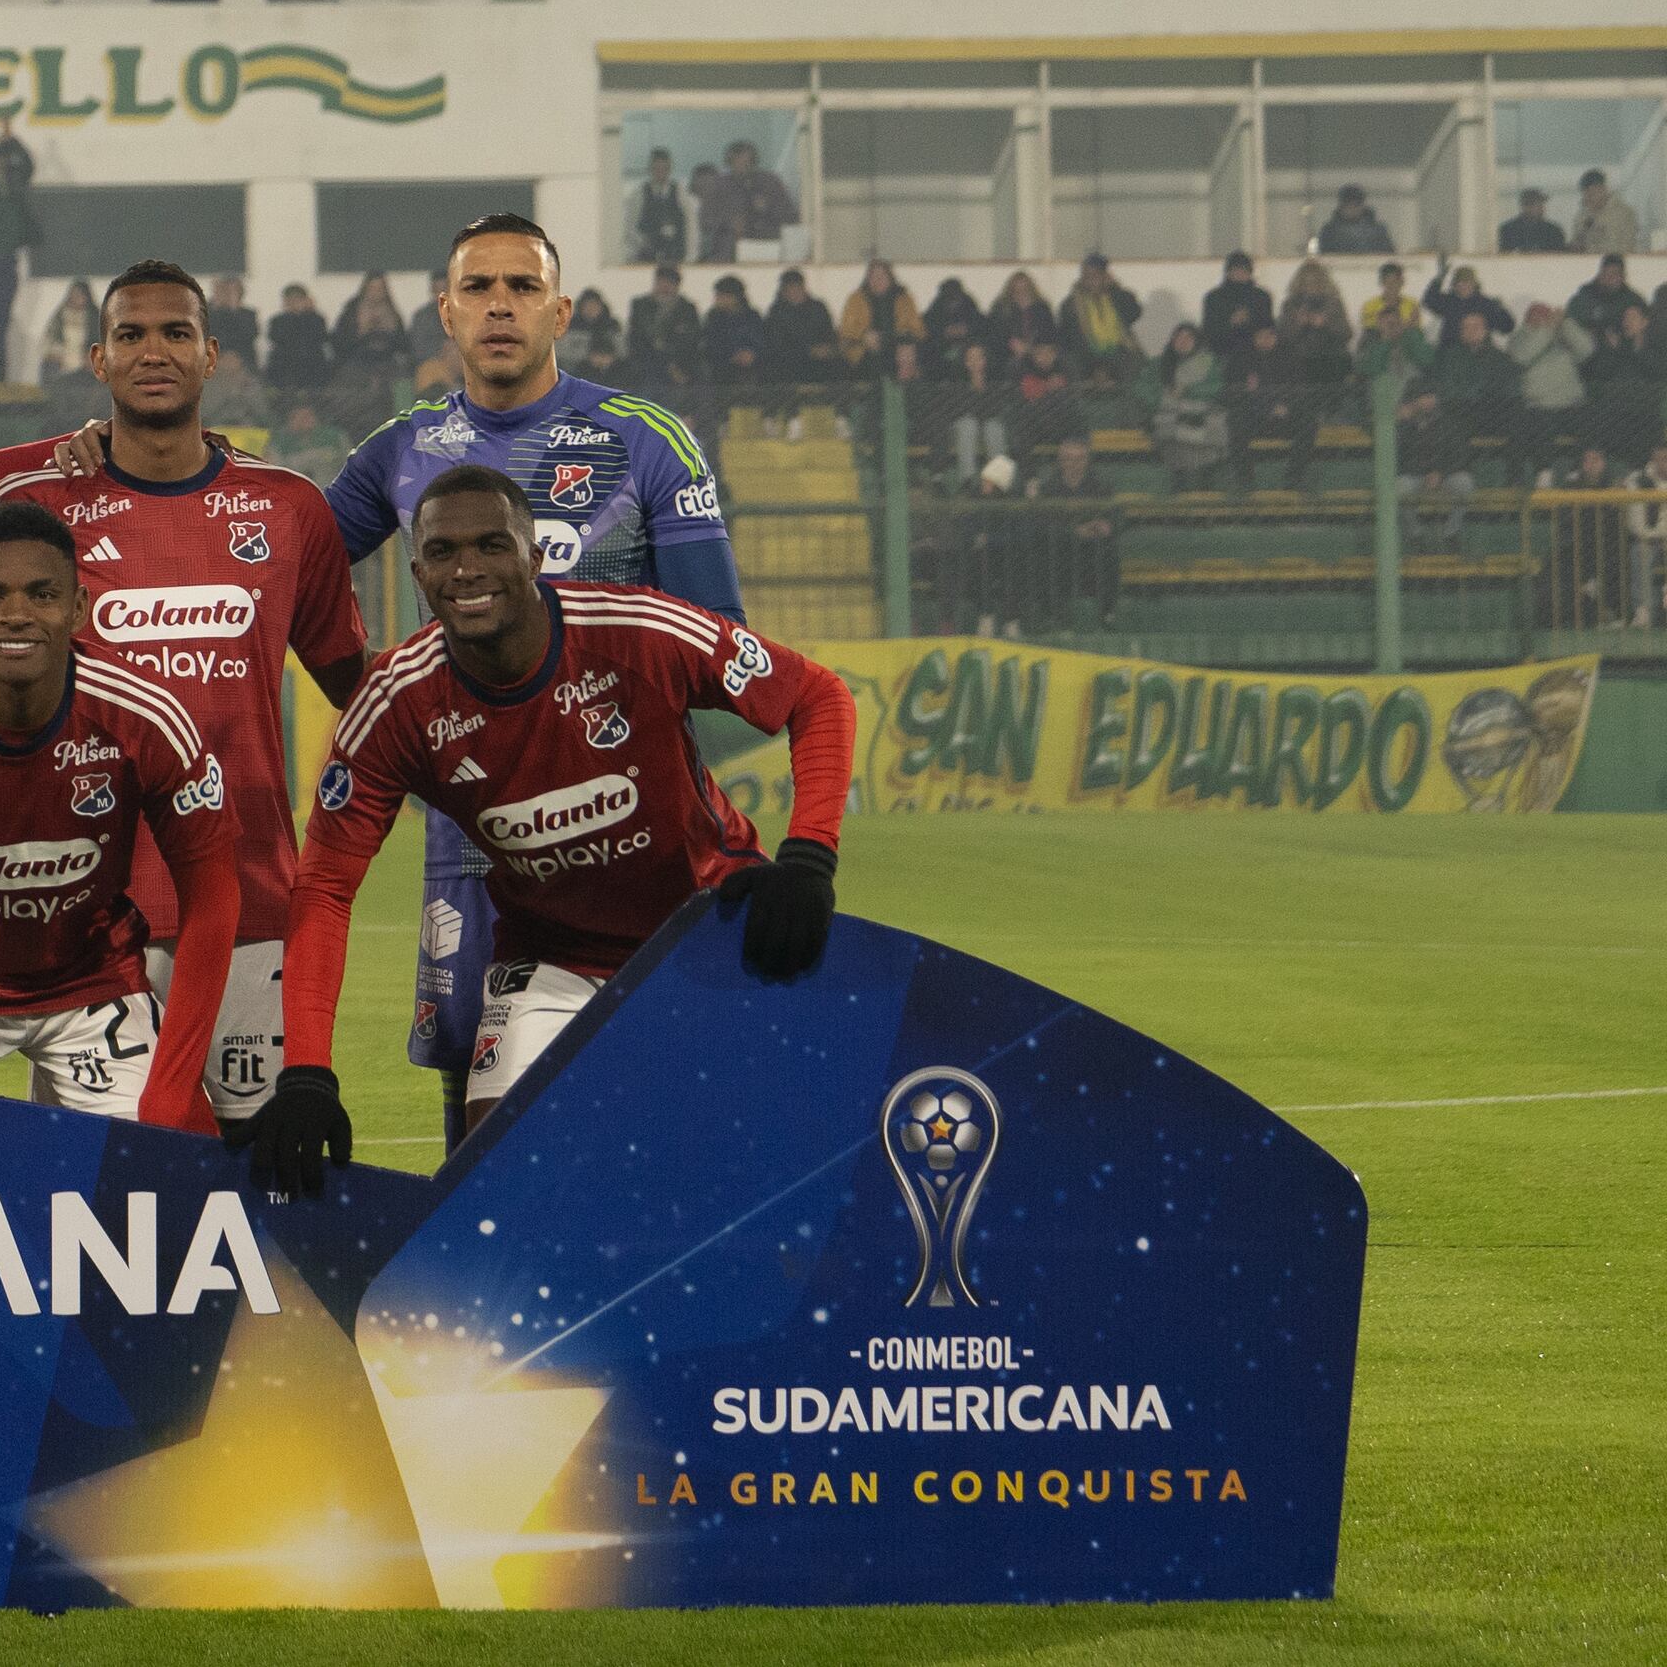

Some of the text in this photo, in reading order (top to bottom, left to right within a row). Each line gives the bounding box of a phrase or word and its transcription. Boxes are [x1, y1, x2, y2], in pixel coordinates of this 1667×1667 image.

[546, 425, 611, 448] Pilsen
[63, 498, 132, 526] Pilsen
[204, 491, 272, 518] Pilsen
[97, 599, 251, 631] Colanta
[555, 671, 620, 714] Pilsen
[893, 647, 1432, 813] SAN EDUARDO
[54, 738, 120, 771] Pilsen
[481, 783, 632, 841] Colanta
[223, 1034, 265, 1045] smart
[221, 1048, 266, 1083] fit
[712, 1384, 1172, 1434] SUDAMERICANA
[637, 1469, 1249, 1508] LA GRAN CONQUISTA
